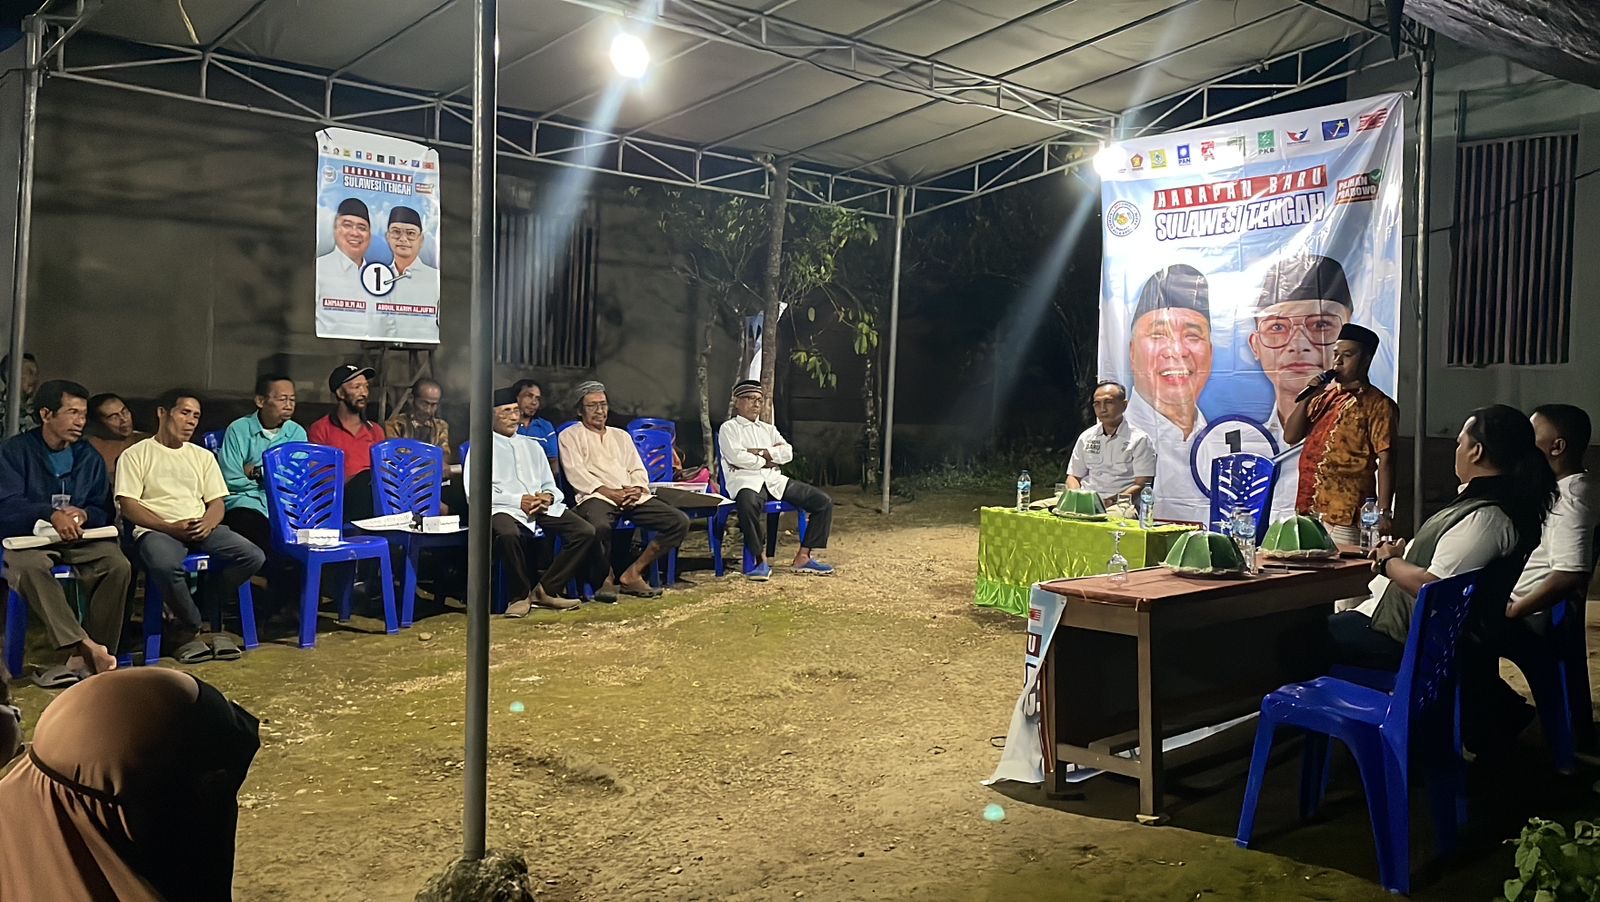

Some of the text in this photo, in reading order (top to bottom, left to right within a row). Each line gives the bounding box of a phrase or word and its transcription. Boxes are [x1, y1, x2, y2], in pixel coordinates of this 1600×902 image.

[1258, 147, 1275, 155] PKB
[344, 165, 386, 179] HARAPAN
[344, 175, 382, 192] SULAWESI
[383, 181, 413, 196] TENGAH
[1157, 167, 1322, 208] HARAPAN BARU
[1155, 205, 1245, 241] SULAWESI
[1246, 191, 1325, 231] TENGAH
[374, 267, 382, 292] 1
[323, 299, 344, 308] AHMAD
[356, 302, 366, 310] ALI
